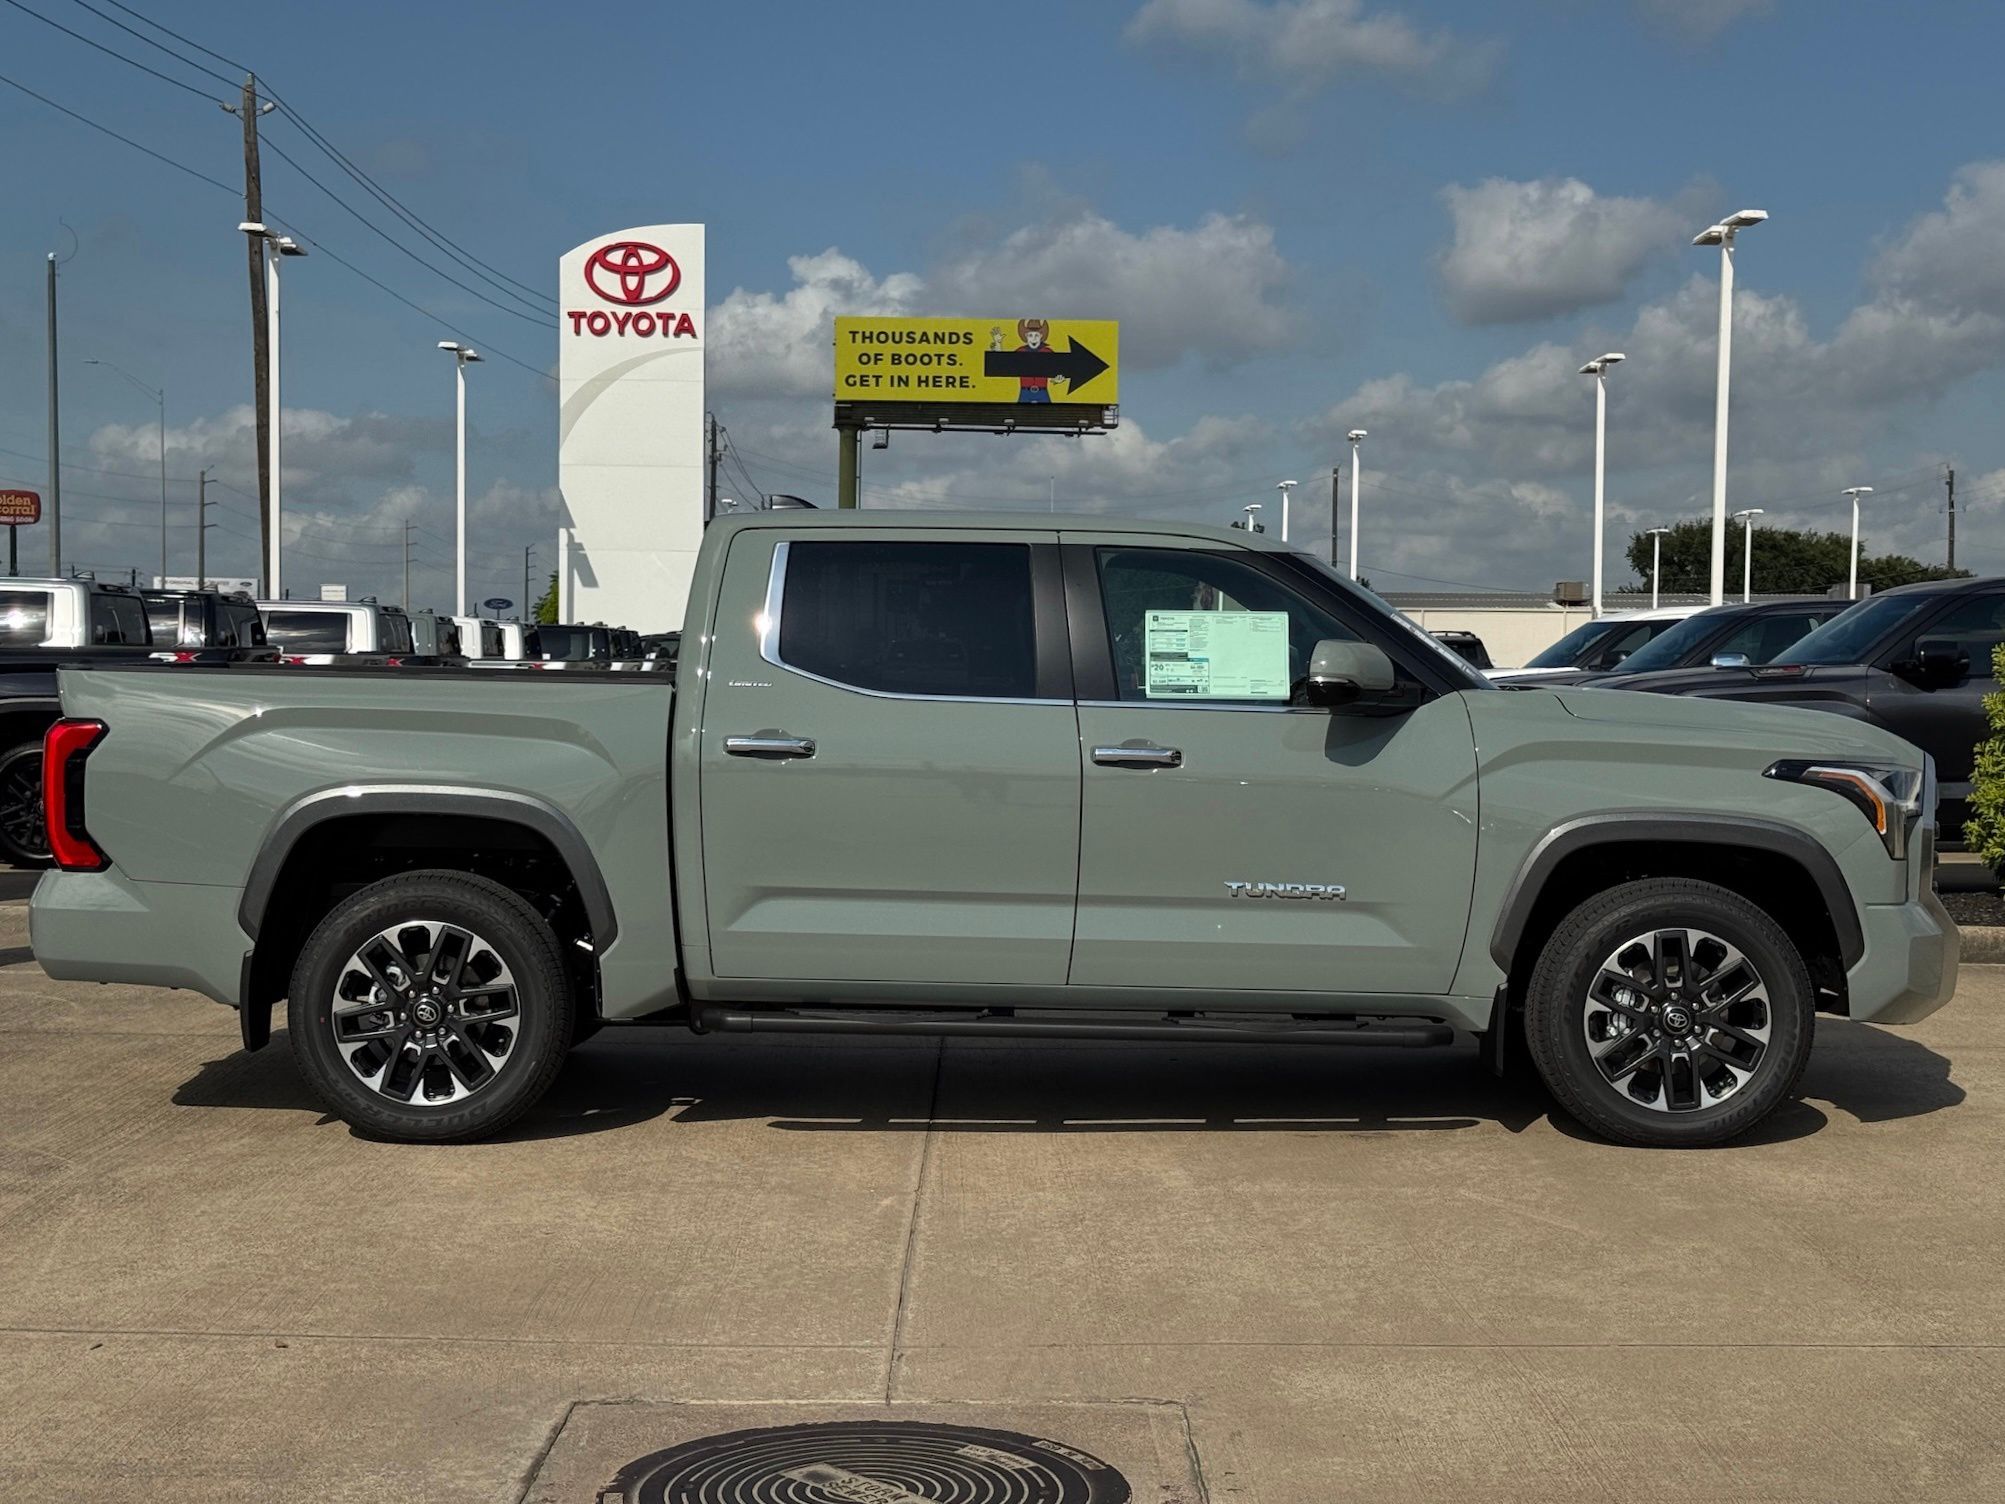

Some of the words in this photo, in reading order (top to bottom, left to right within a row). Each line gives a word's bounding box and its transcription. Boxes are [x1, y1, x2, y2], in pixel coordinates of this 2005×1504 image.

[567, 311, 698, 340] TOYOTA
[848, 329, 974, 346] THOUSANDS
[857, 352, 884, 366] OF
[890, 352, 964, 367] BOOTS.
[844, 374, 883, 388] GET
[889, 375, 910, 388] IN
[917, 375, 976, 389] HERE.
[1224, 881, 1346, 901] TUNDRA
[840, 1476, 909, 1502] STORM
